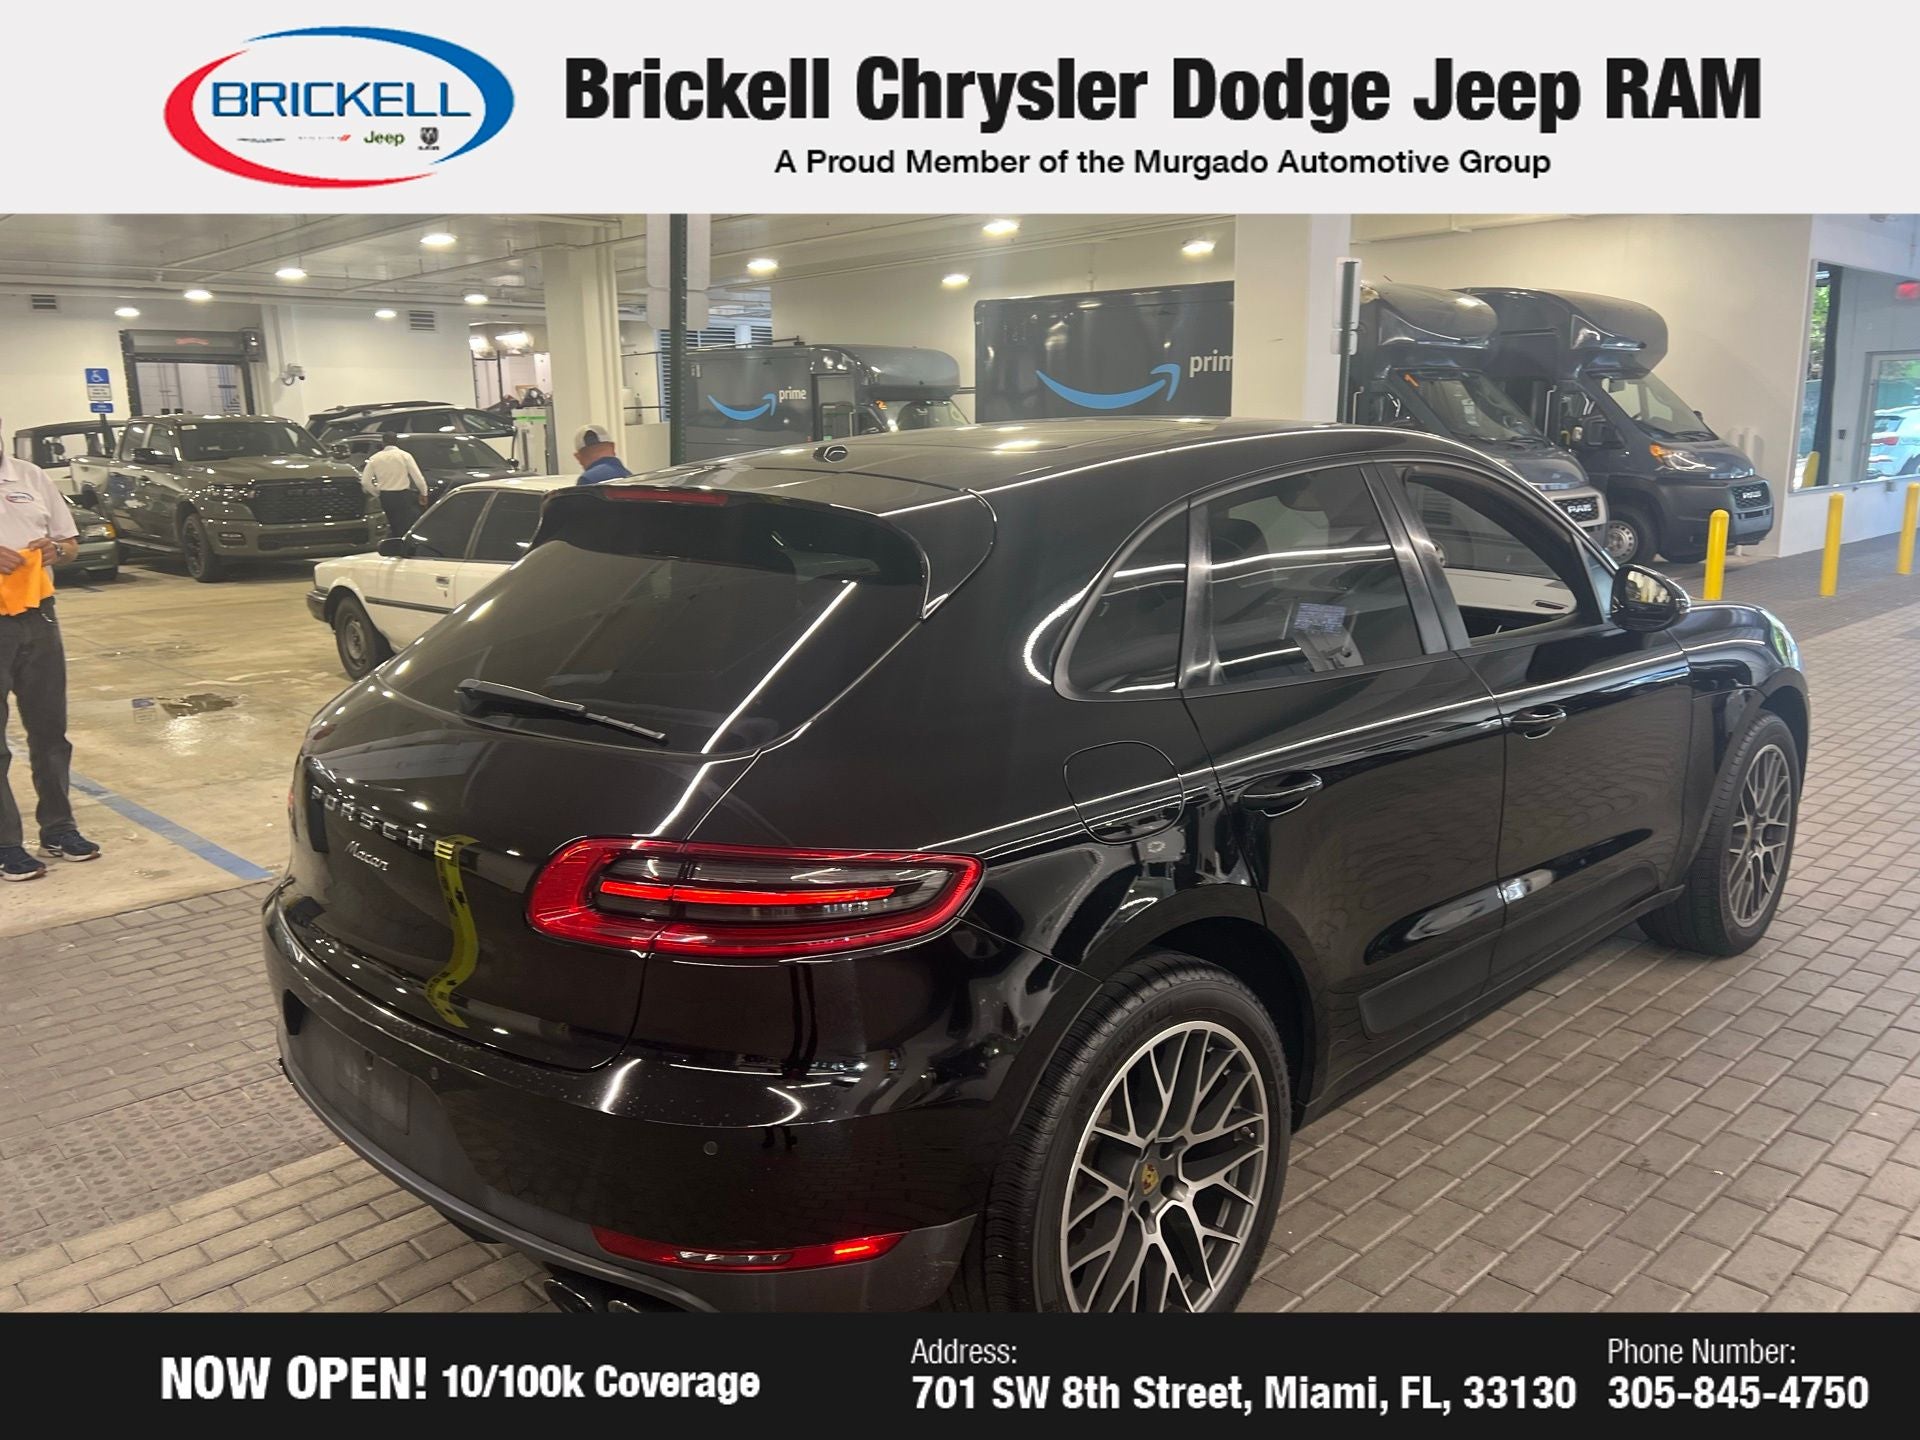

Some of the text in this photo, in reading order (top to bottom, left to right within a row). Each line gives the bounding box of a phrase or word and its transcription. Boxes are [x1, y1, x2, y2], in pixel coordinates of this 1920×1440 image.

[1189, 349, 1233, 378] prim
[778, 386, 807, 402] prime
[311, 785, 455, 860] PORSCHE
[345, 840, 389, 871] Macan
